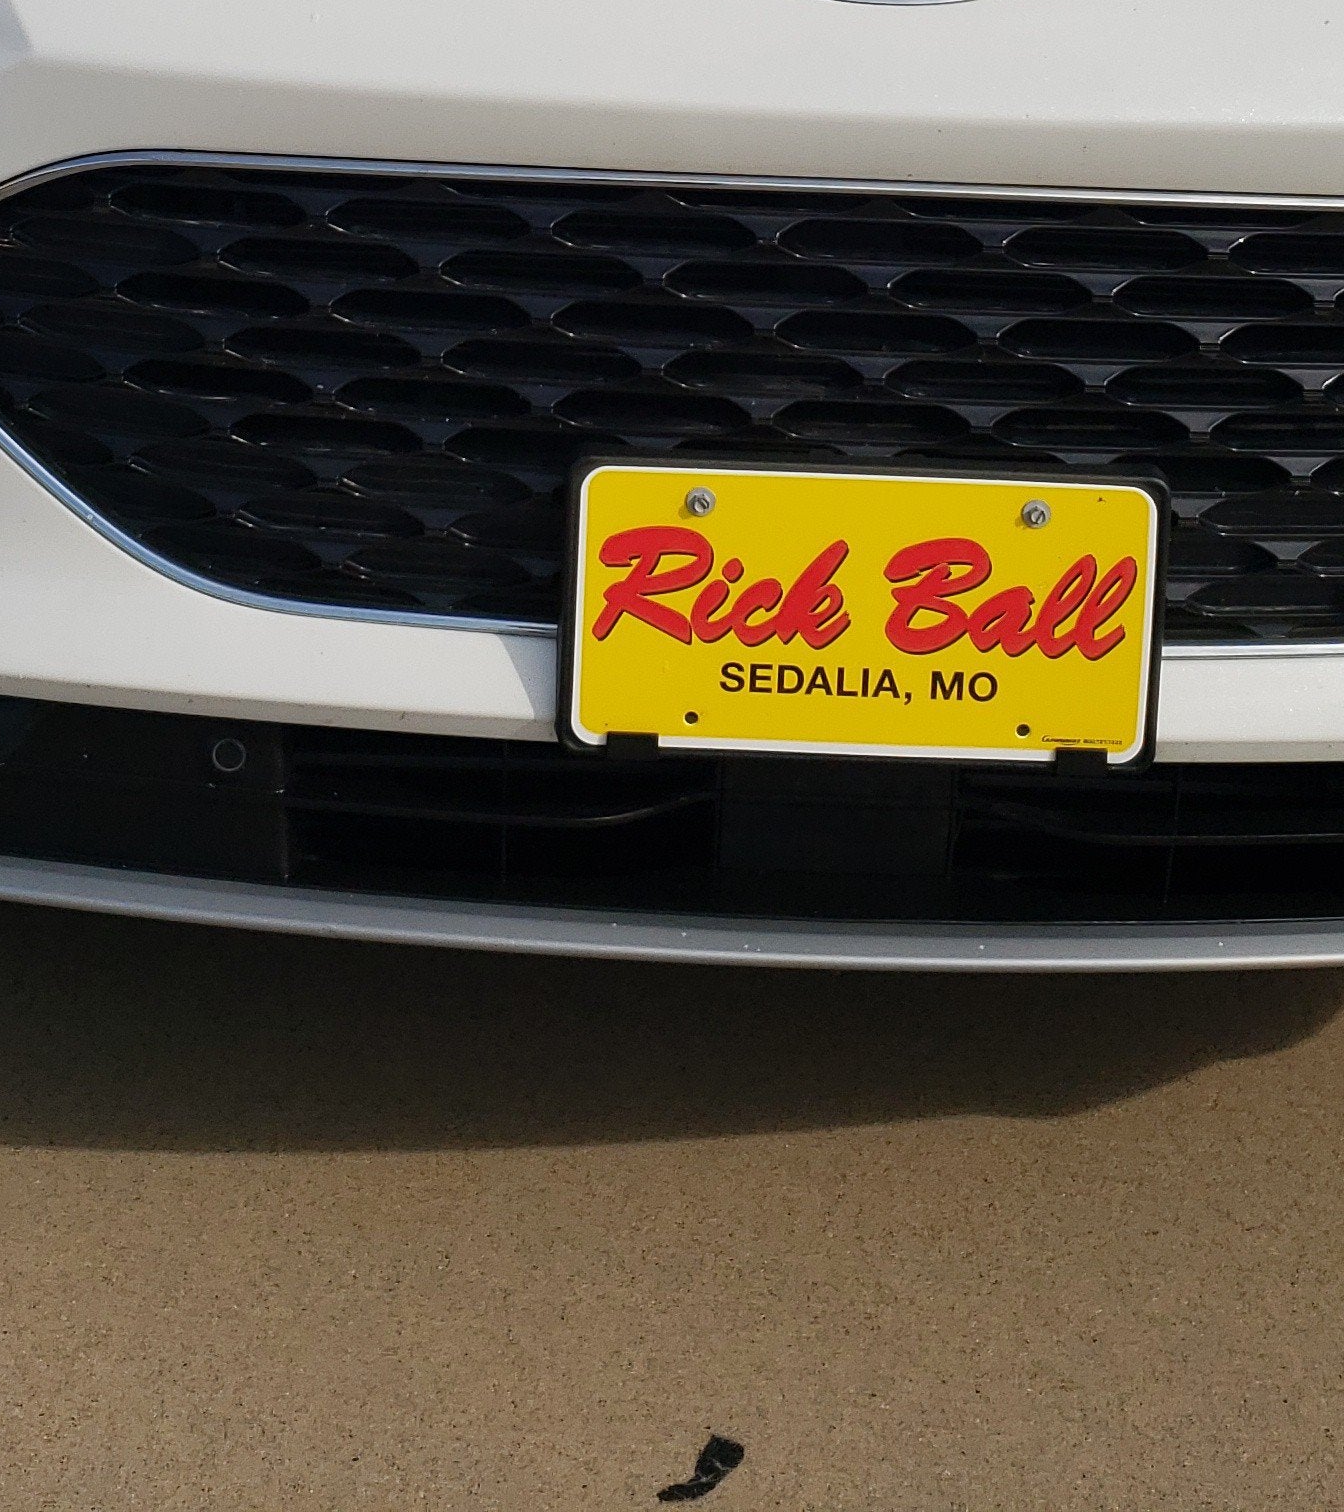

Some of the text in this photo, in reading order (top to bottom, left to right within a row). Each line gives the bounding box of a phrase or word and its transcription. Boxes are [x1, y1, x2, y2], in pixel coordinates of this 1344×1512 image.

[591, 525, 1138, 661] Rick Ball
[719, 661, 999, 706] SEDALIA, MO
